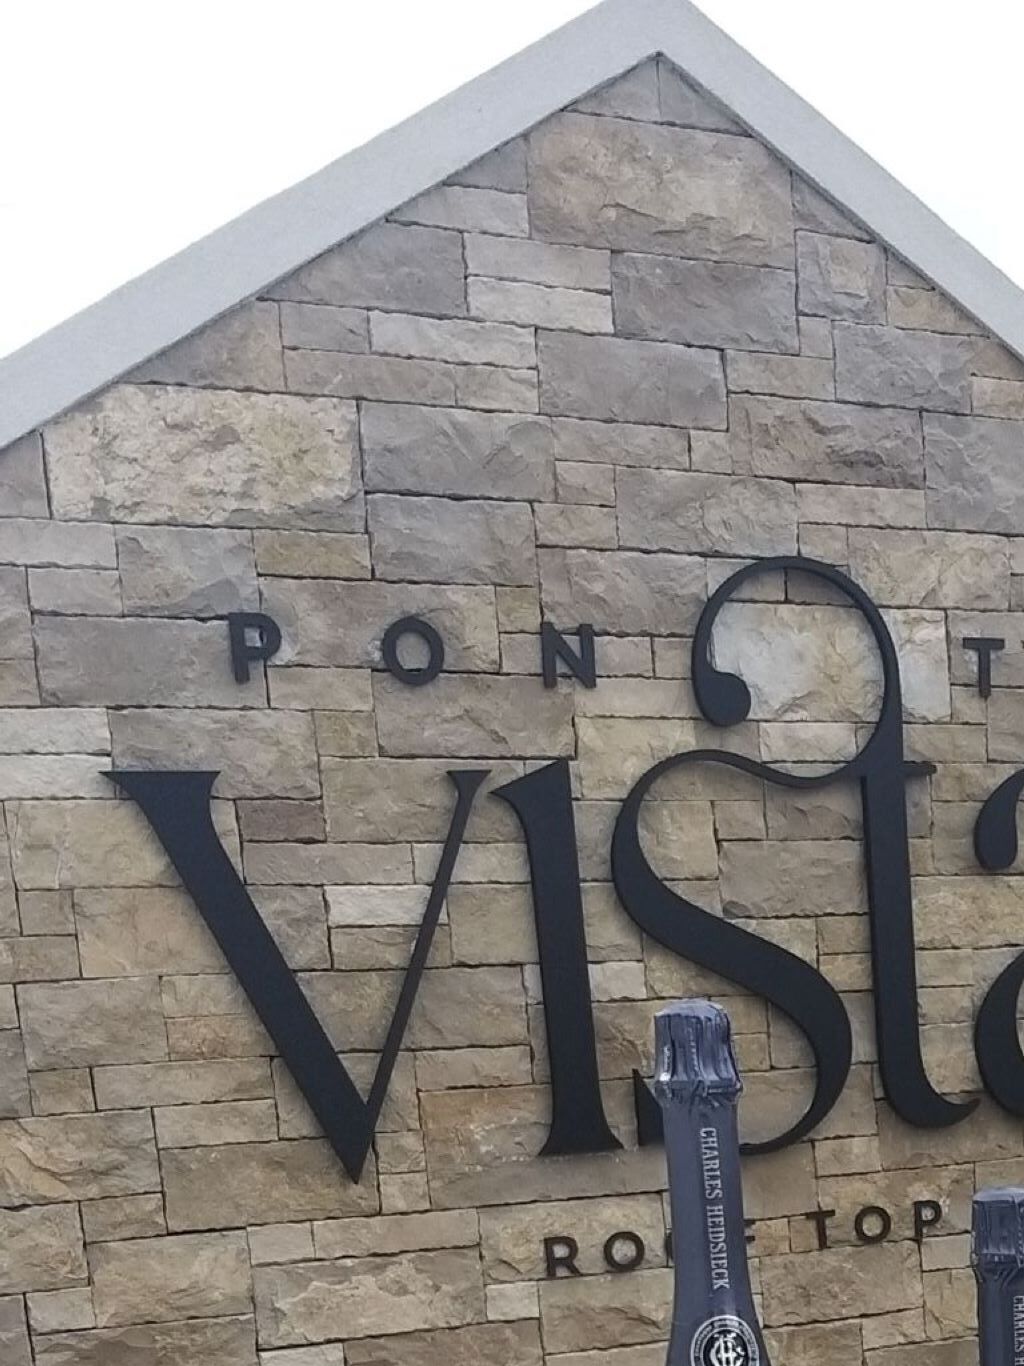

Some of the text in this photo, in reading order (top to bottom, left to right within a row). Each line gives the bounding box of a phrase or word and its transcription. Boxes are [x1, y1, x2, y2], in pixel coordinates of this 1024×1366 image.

[699, 1126, 731, 1291] CHARLES HEIDSIECK
[806, 1200, 943, 1250] TOP
